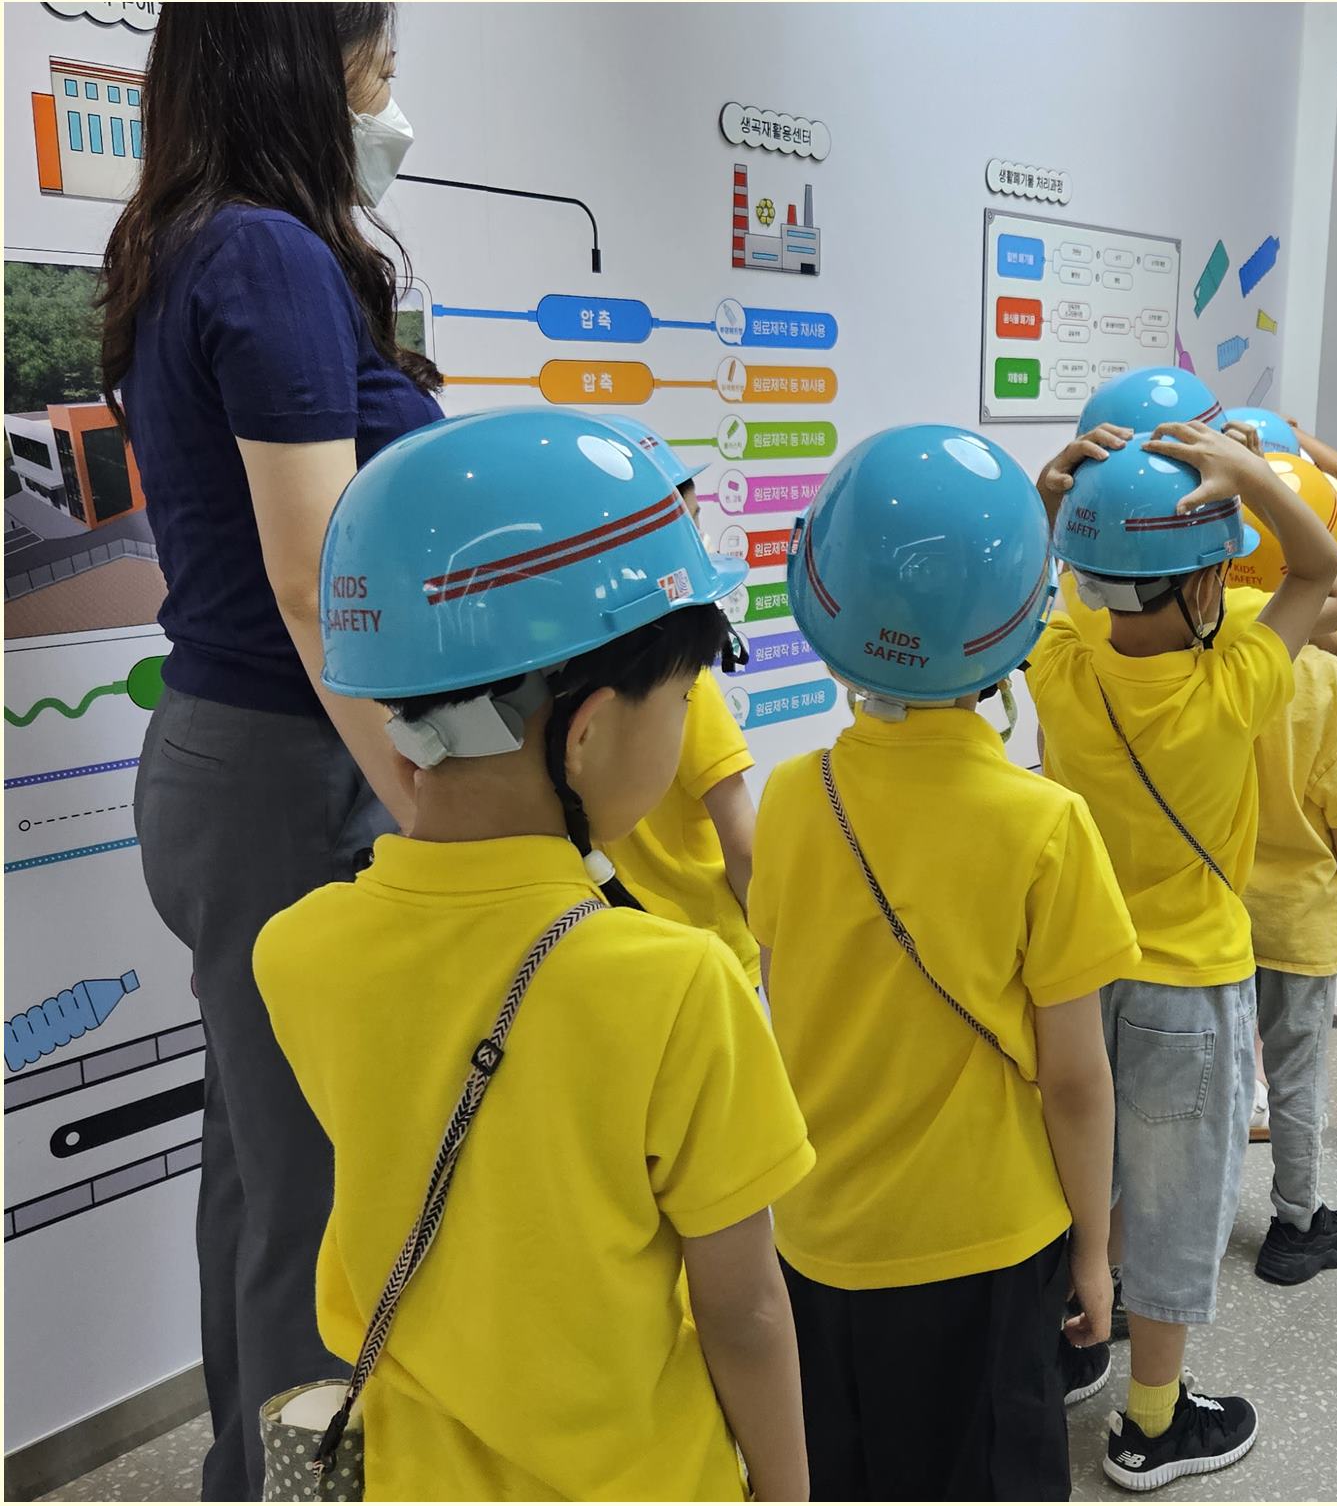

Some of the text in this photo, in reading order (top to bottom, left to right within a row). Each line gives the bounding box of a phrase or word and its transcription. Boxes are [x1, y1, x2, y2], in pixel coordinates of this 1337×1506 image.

[740, 115, 812, 147] 생곡재활용센터
[999, 169, 1064, 194] 생활폐기물 처리과정
[752, 320, 826, 338] 원료제작 등 재사용
[752, 376, 826, 393] 원료제작 등 재사용
[753, 431, 826, 448] 원료제작 등 재사용
[753, 485, 789, 502] 원료제작
[790, 486, 799, 500] 등
[800, 484, 819, 499] 재사
[1075, 506, 1097, 522] KIDS
[1066, 520, 1100, 541] SAFETY
[1229, 572, 1263, 587] SAFETY
[1232, 564, 1256, 576] KIDS
[332, 575, 368, 599] KIDS
[326, 608, 381, 634] SAFETY
[879, 627, 921, 650] KIDS
[755, 645, 789, 662] 원료제작
[791, 643, 799, 656] 등
[864, 641, 931, 669] SAFETY
[755, 691, 826, 717] 원료제작 등 재사용
